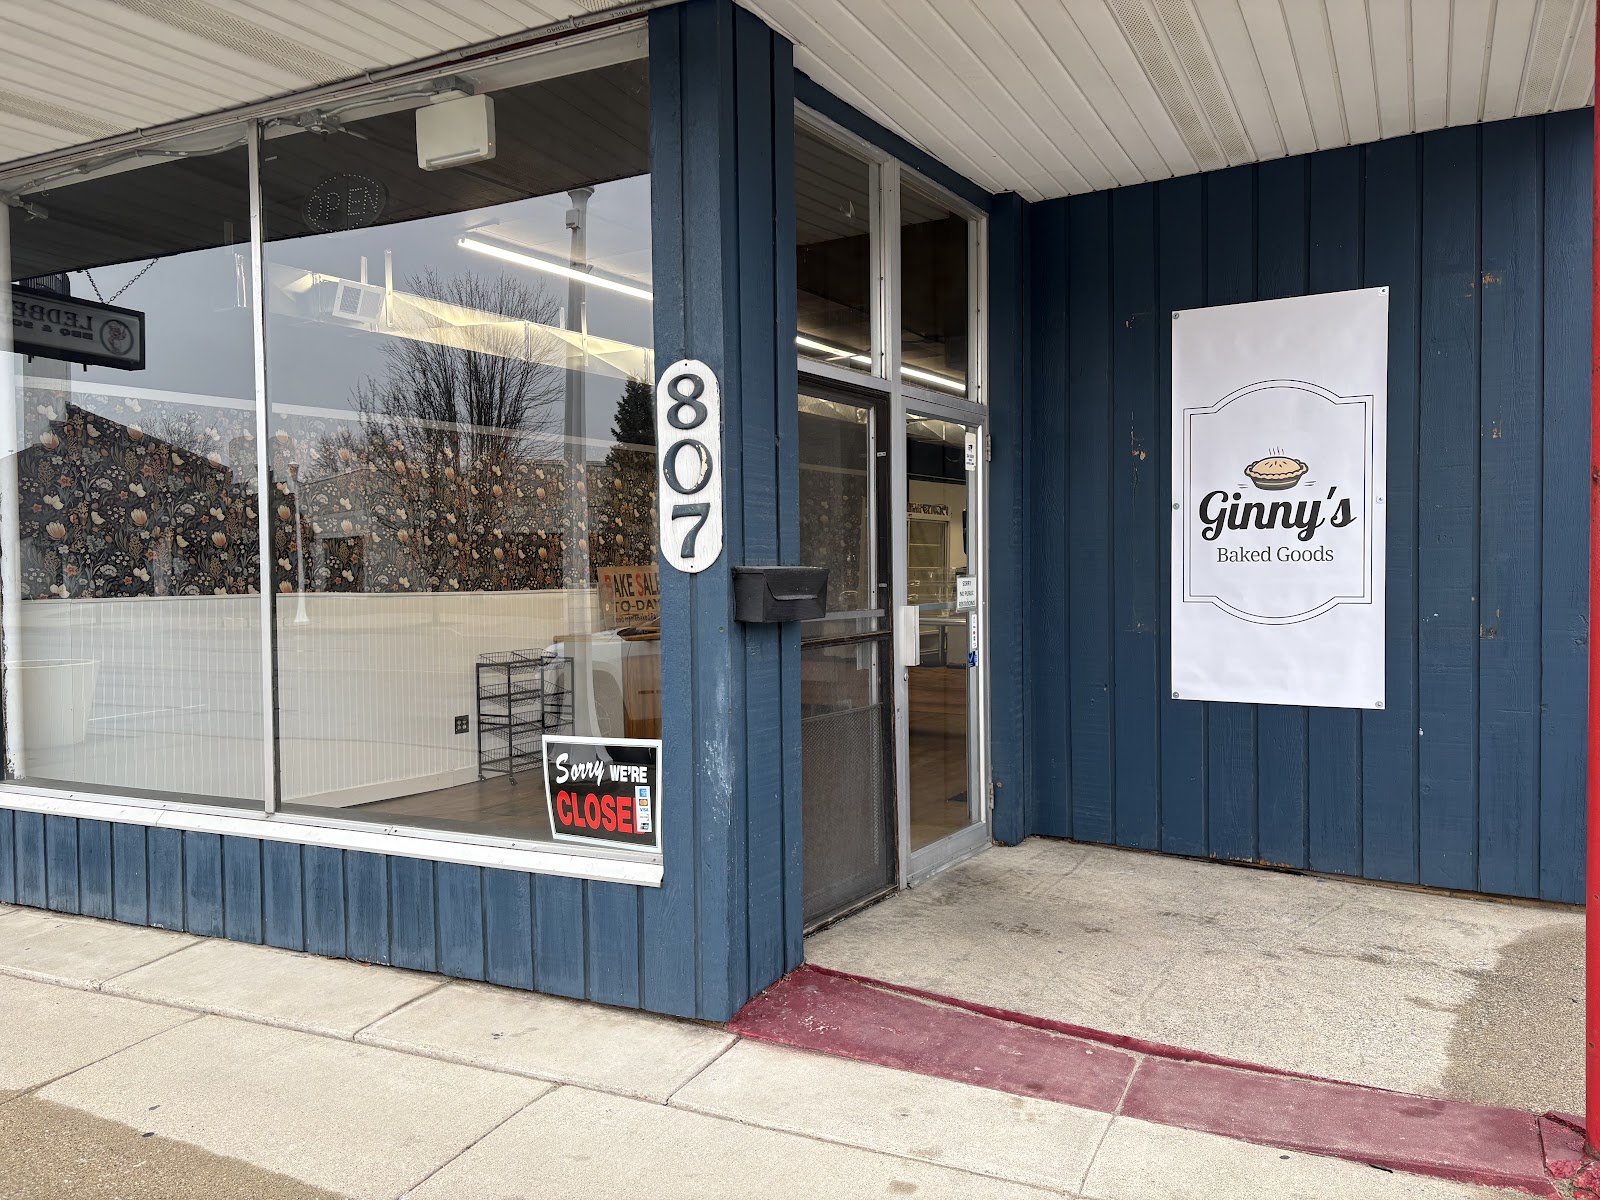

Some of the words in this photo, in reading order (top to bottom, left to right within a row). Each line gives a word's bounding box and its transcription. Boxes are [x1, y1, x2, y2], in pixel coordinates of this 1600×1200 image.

[307, 186, 379, 222] OPEN
[662, 373, 714, 559] 807
[1199, 486, 1357, 542] Ginny's
[1216, 546, 1272, 563] Baked
[1276, 545, 1334, 563] Goods
[604, 573, 635, 599] BAKE
[556, 752, 605, 787] Sorry
[609, 764, 648, 783] WE'RE
